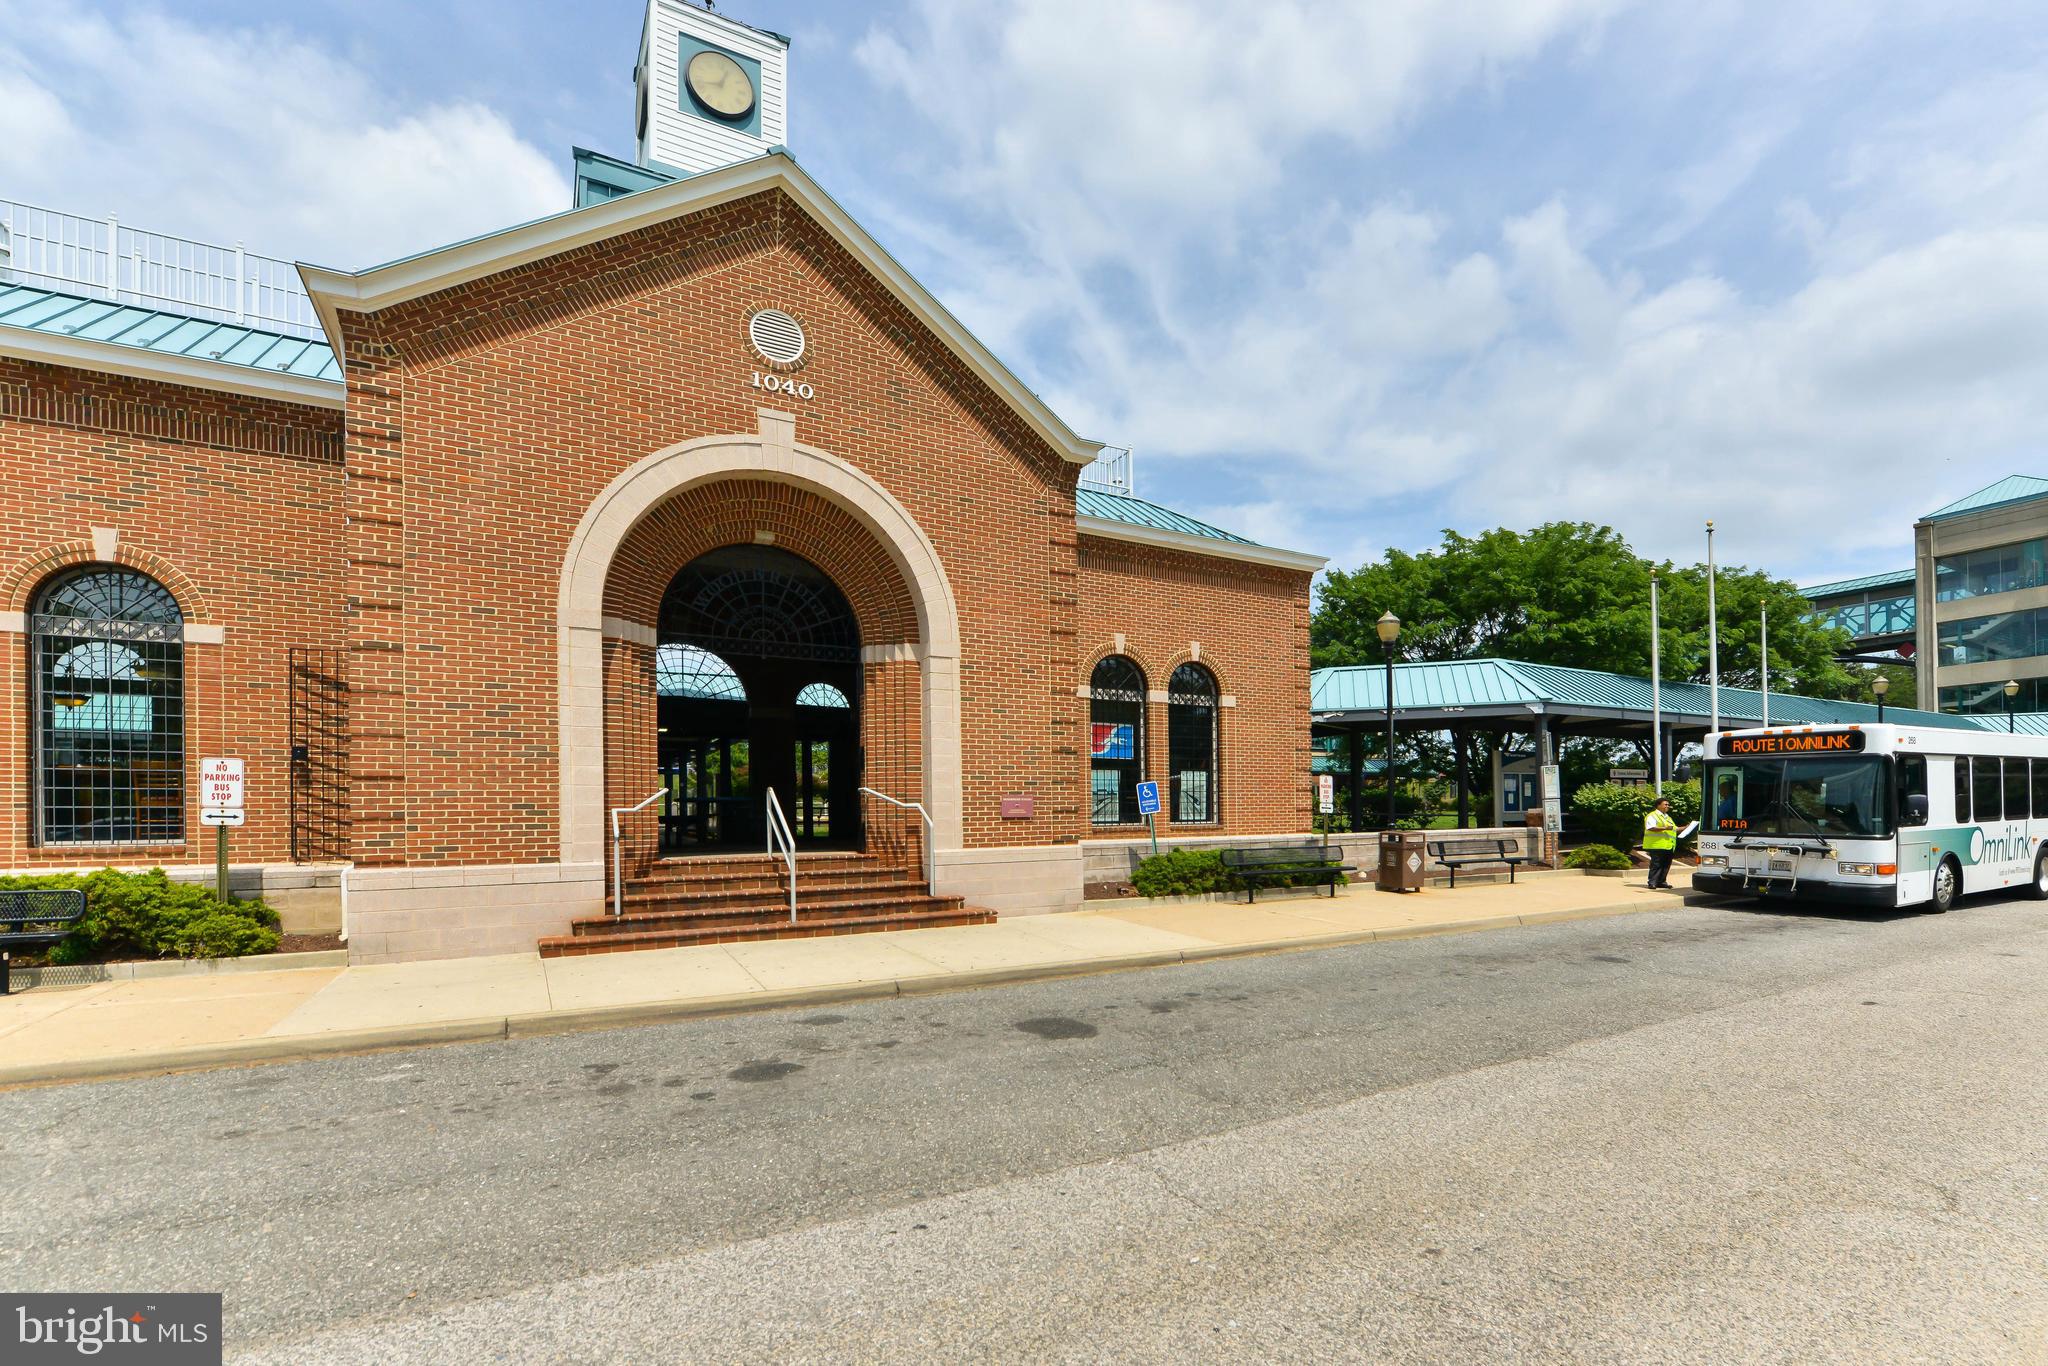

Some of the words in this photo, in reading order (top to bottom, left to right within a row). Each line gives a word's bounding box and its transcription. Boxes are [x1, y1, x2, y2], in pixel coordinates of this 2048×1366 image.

[751, 371, 814, 400] 1040
[1732, 738, 1776, 753] ROUTE
[1778, 739, 1784, 751] 1
[1785, 735, 1850, 751] OMNILINK
[216, 764, 228, 772] NO
[204, 774, 240, 782] PARKING
[211, 792, 232, 800] STOP
[1720, 819, 1748, 829] RT1A
[1701, 841, 1717, 850] 268
[1970, 820, 2032, 866] OmniLink
